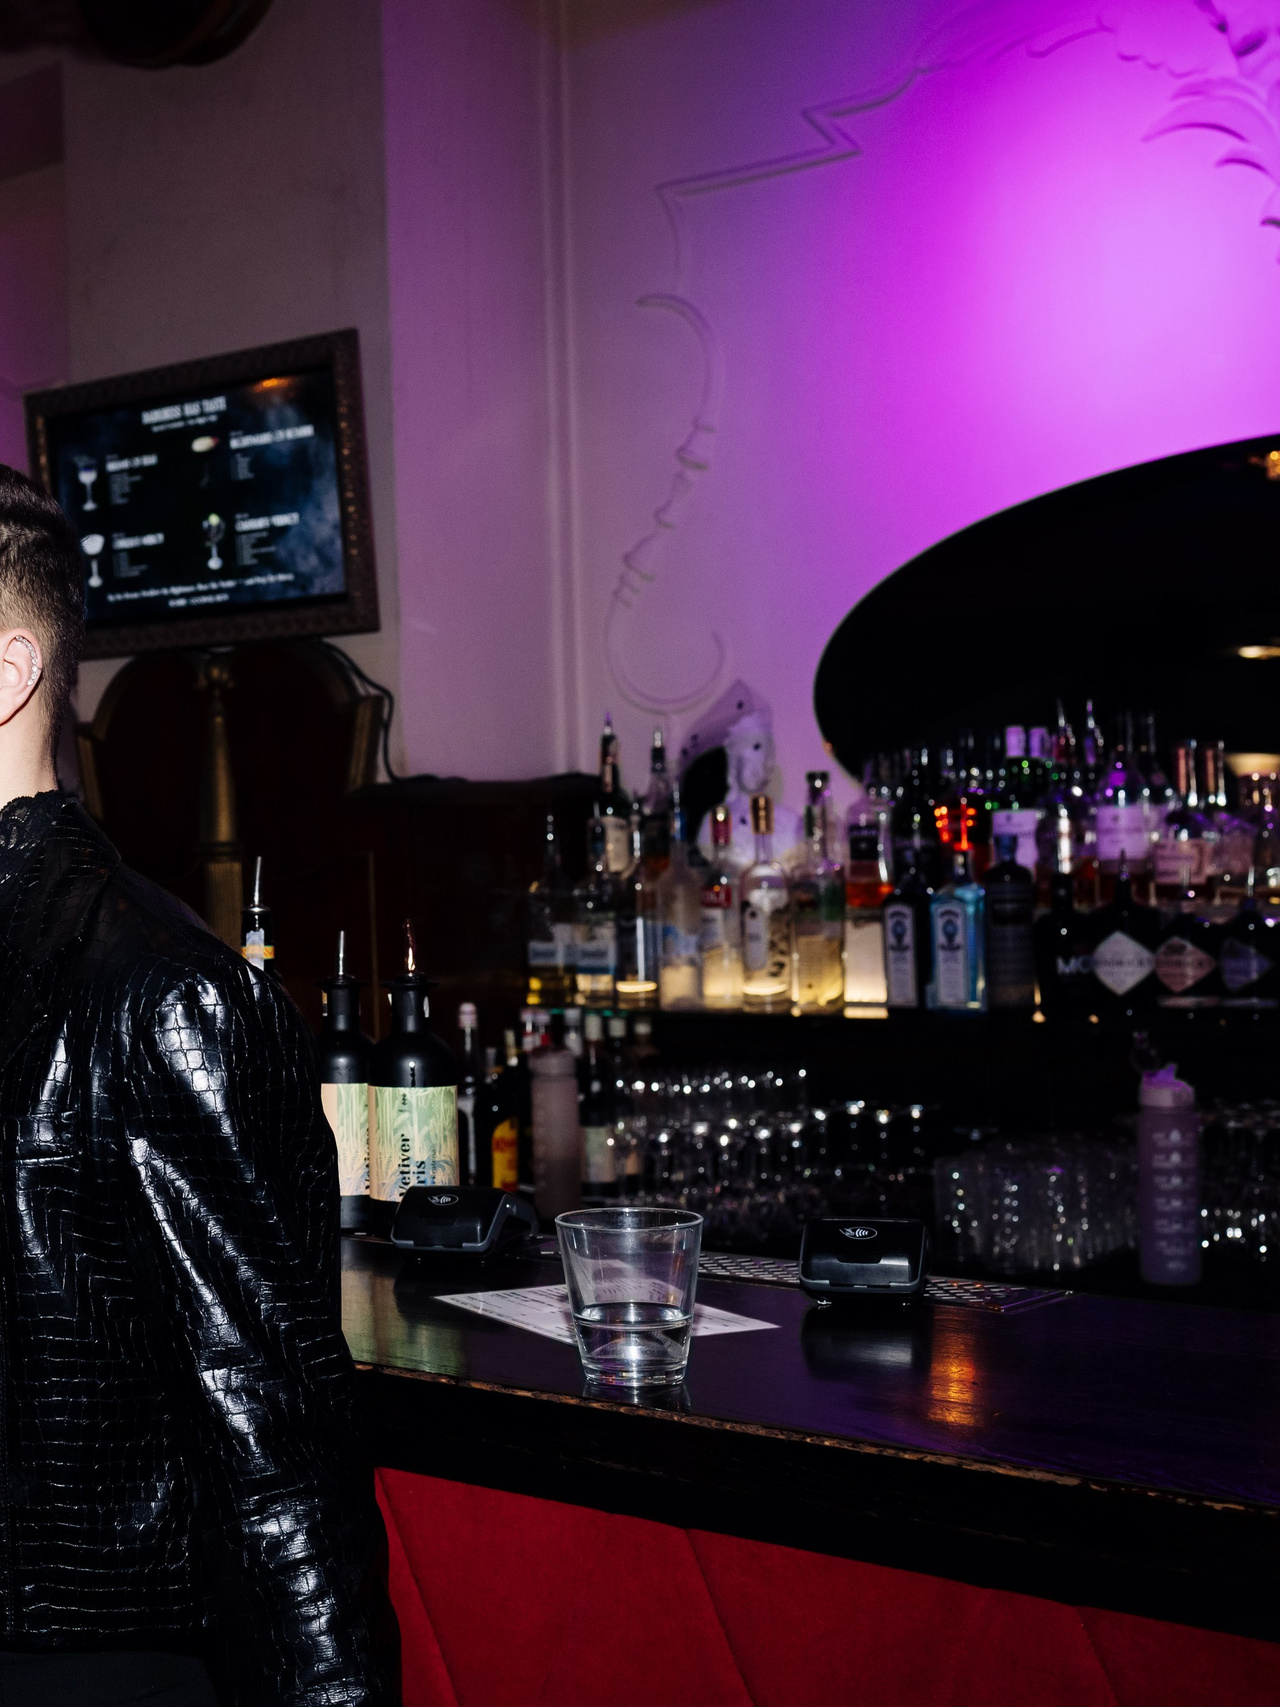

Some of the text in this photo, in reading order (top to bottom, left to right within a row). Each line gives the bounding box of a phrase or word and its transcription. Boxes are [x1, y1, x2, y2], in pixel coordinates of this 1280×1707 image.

[1055, 955, 1095, 976] MO
[398, 1133, 411, 1197] Vetiver
[412, 1160, 426, 1185] ris
